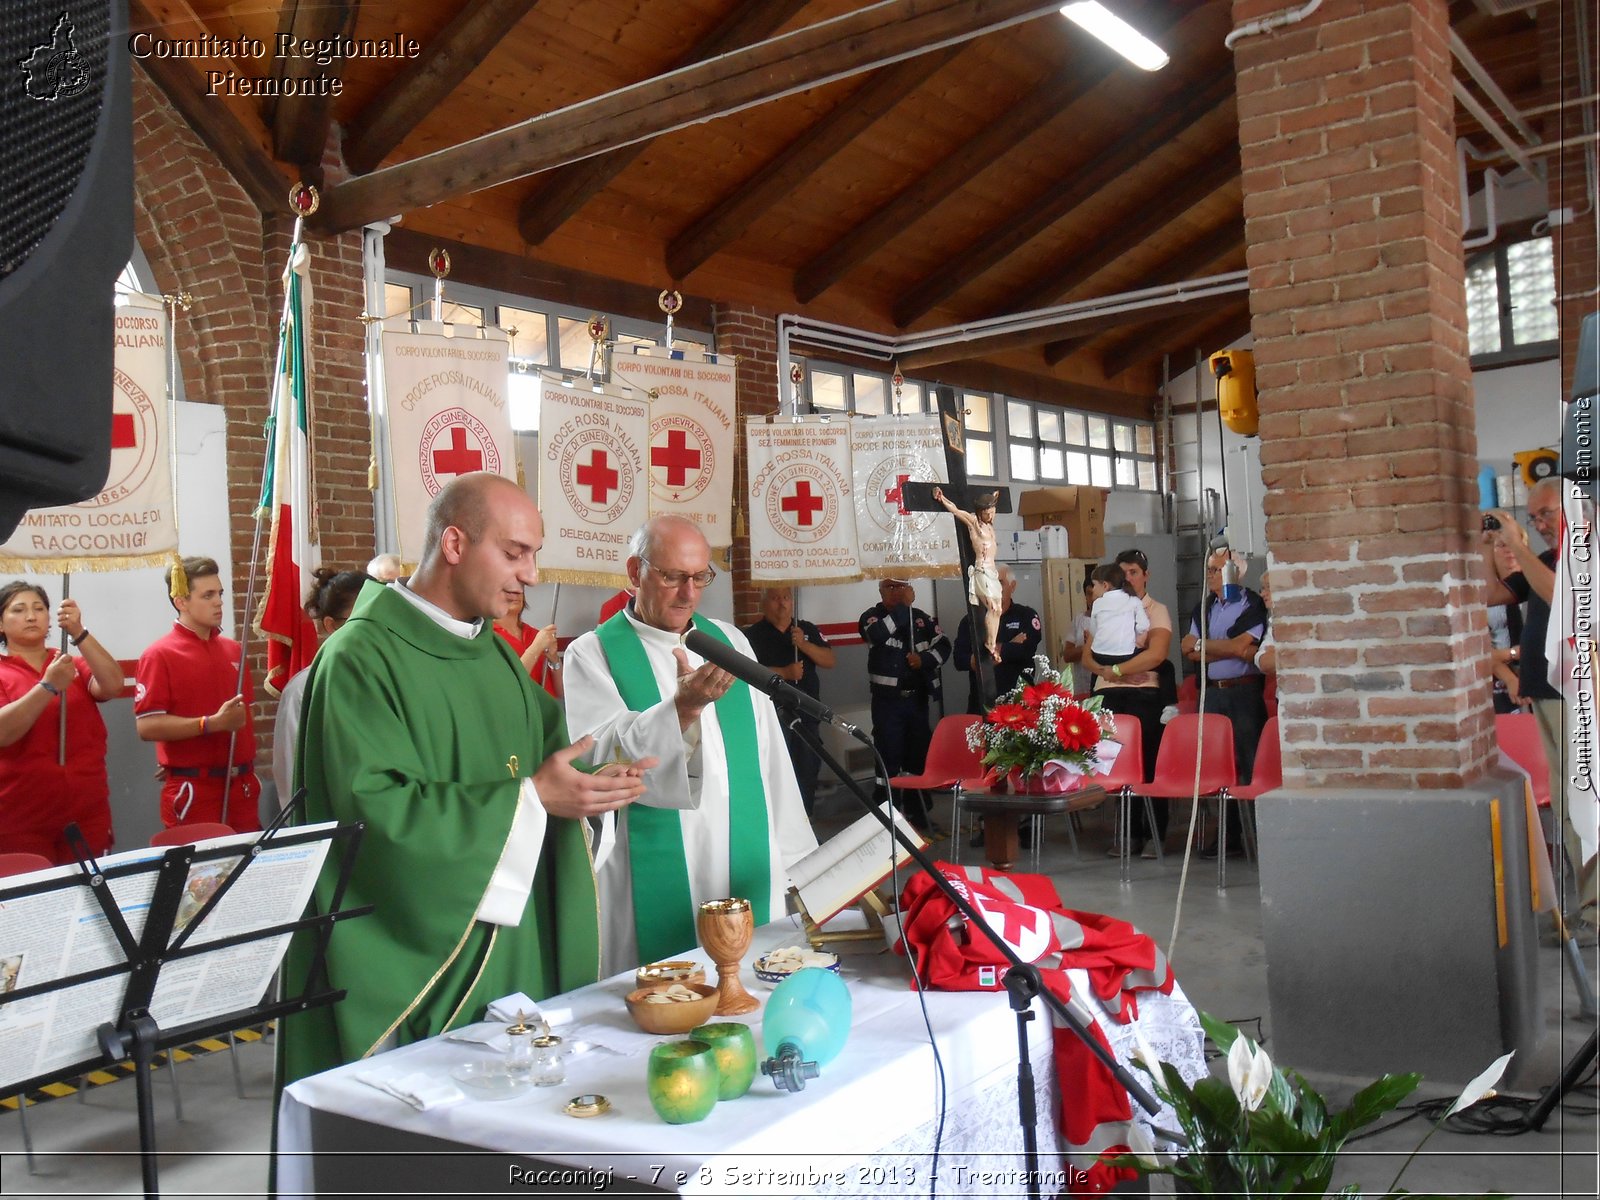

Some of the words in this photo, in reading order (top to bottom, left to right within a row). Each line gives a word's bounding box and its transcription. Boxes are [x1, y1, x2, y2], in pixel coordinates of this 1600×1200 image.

[115, 317, 158, 330] OCCORSO
[115, 334, 166, 349] ALIANA
[395, 346, 419, 357] CORPO
[467, 351, 500, 362] SOCCORSO
[617, 362, 641, 373] CORPO
[644, 364, 681, 378] VOLONTARI
[683, 369, 694, 379] DEL
[697, 372, 731, 383] SOCCORSO
[114, 372, 151, 414] NEVRA
[400, 377, 433, 412] CROCE
[465, 375, 505, 410] ITALIANA
[545, 390, 567, 404] CORPO
[569, 395, 602, 410] VOLONTARI
[604, 401, 614, 412] DEL
[616, 404, 645, 417] SOCCORSO
[694, 391, 731, 430] ITALIANA
[651, 423, 661, 432] DI
[661, 417, 695, 431] GINEVRA
[579, 431, 614, 448] GINEVRA
[694, 427, 704, 438] 22
[751, 428, 770, 437] CORPO
[772, 428, 804, 437] VOLONTARI
[805, 428, 817, 436] DEL
[820, 427, 846, 436] SOCCORSO
[547, 420, 575, 461] CROCE
[575, 413, 610, 429] ROSSA
[614, 423, 642, 474] ITALIANA
[571, 439, 580, 450] DI
[774, 438, 806, 447] FEMMINILE
[812, 438, 836, 446] PIONIERI
[851, 441, 880, 452] CROCE
[882, 440, 911, 450] ROSSA
[421, 427, 439, 495] ONVENZIONE
[431, 419, 442, 431] DI
[473, 423, 485, 436] 22
[482, 435, 497, 474] AGOST
[615, 446, 624, 458] 22
[702, 438, 713, 474] AGOSTO
[752, 461, 776, 497] CROCE
[775, 449, 812, 465] ROSSA
[816, 452, 850, 496] ITALIANA
[777, 473, 786, 484] DI
[789, 466, 823, 480] GINEVRA
[562, 449, 588, 518] CONVENZIONE
[621, 462, 632, 503] AGOSTO
[695, 476, 708, 491] 1864
[823, 480, 833, 492] 22
[96, 485, 129, 505] 1864
[768, 485, 797, 539] CONVENZIONE
[827, 493, 837, 524] AGOSTO
[18, 513, 81, 527] OMITATO
[89, 511, 148, 527] LOCALE
[150, 509, 161, 522] DI
[707, 513, 717, 524] DI
[32, 532, 147, 550] RACCONIGI
[626, 535, 633, 545] D
[941, 539, 951, 549] DI
[576, 546, 619, 561] BARGE
[760, 548, 804, 558] COMITATO
[806, 547, 838, 556] LOCALE
[841, 548, 849, 556] DI
[754, 560, 789, 569] BORGO
[792, 560, 802, 569] S.
[805, 557, 856, 568] DALMAZZO
